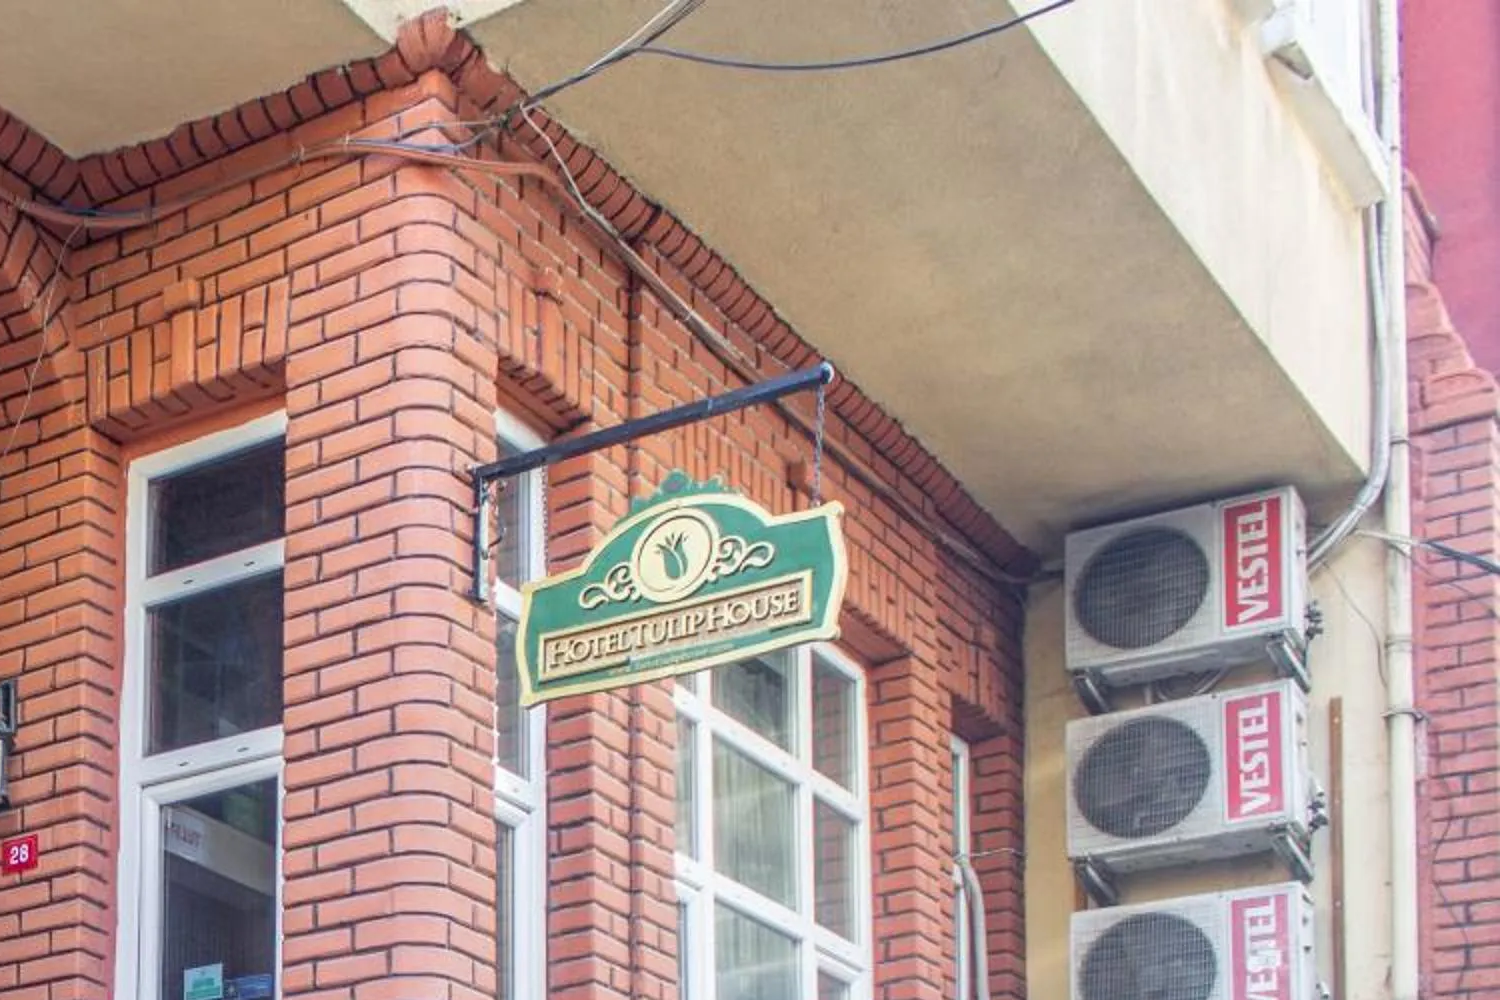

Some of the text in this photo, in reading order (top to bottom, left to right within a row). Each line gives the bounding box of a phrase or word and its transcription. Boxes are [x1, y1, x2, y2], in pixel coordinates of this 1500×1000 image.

[1237, 499, 1270, 624] VESTEL
[550, 629, 632, 669] HOTEL
[630, 610, 706, 649] TULIP
[707, 590, 800, 632] HOUSE
[1238, 697, 1272, 816] VESTEL
[10, 843, 29, 865] 28
